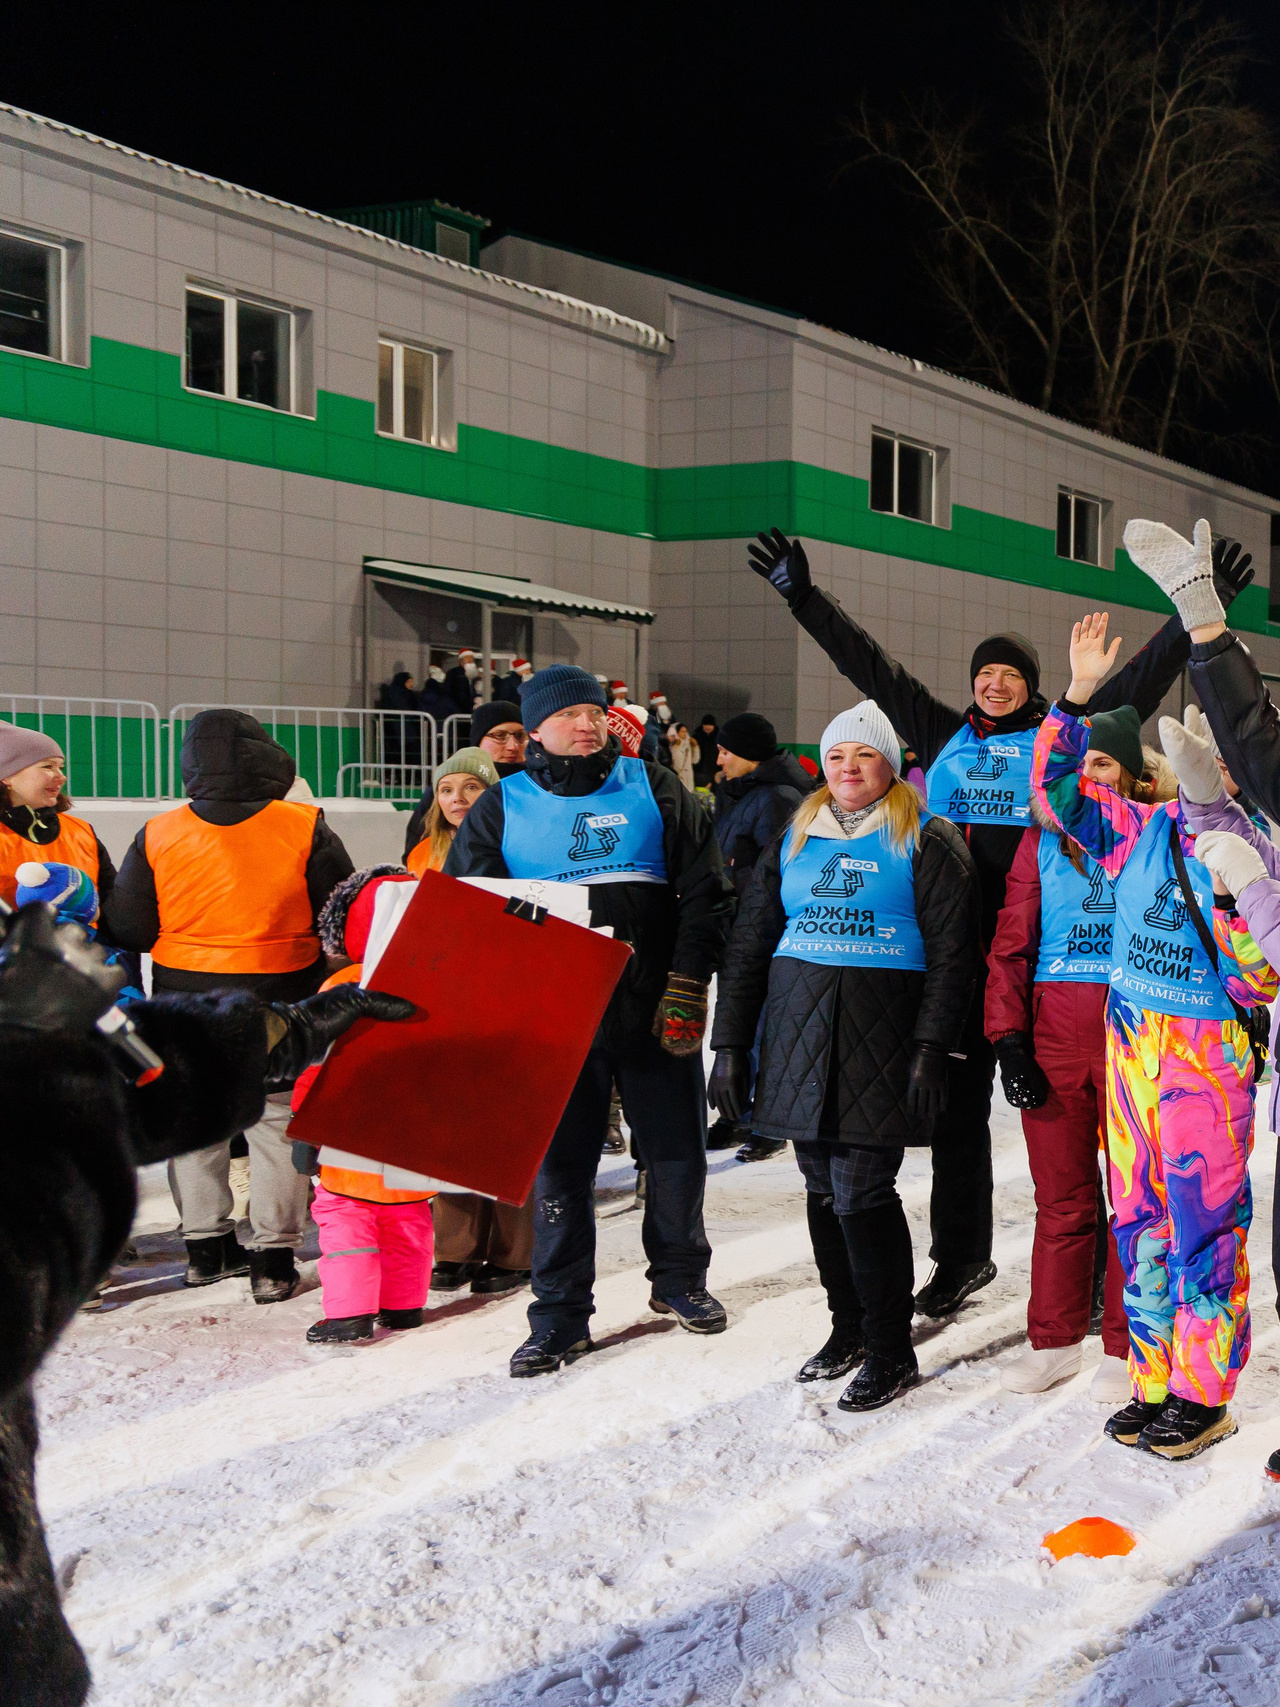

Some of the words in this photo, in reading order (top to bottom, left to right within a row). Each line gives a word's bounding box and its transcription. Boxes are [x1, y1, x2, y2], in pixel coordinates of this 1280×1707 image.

[993, 747, 1016, 755] 100
[949, 788, 1015, 803] ЛЫЖНЯ
[948, 802, 1013, 816] РОССИИ
[593, 815, 622, 826] 100
[845, 860, 874, 870] 100
[799, 906, 875, 923] ЛЫЖНЯ
[795, 920, 875, 937] РОССИИ
[1067, 923, 1114, 939] ЛЫЖ
[790, 942, 906, 956] АСТРАМЕД-МС
[1067, 940, 1112, 956] РОСС
[1129, 933, 1194, 963] ЛЫЖНЯ
[1128, 950, 1192, 982] РОССИИ
[1122, 977, 1214, 1006] АСТРАМЕД-МС
